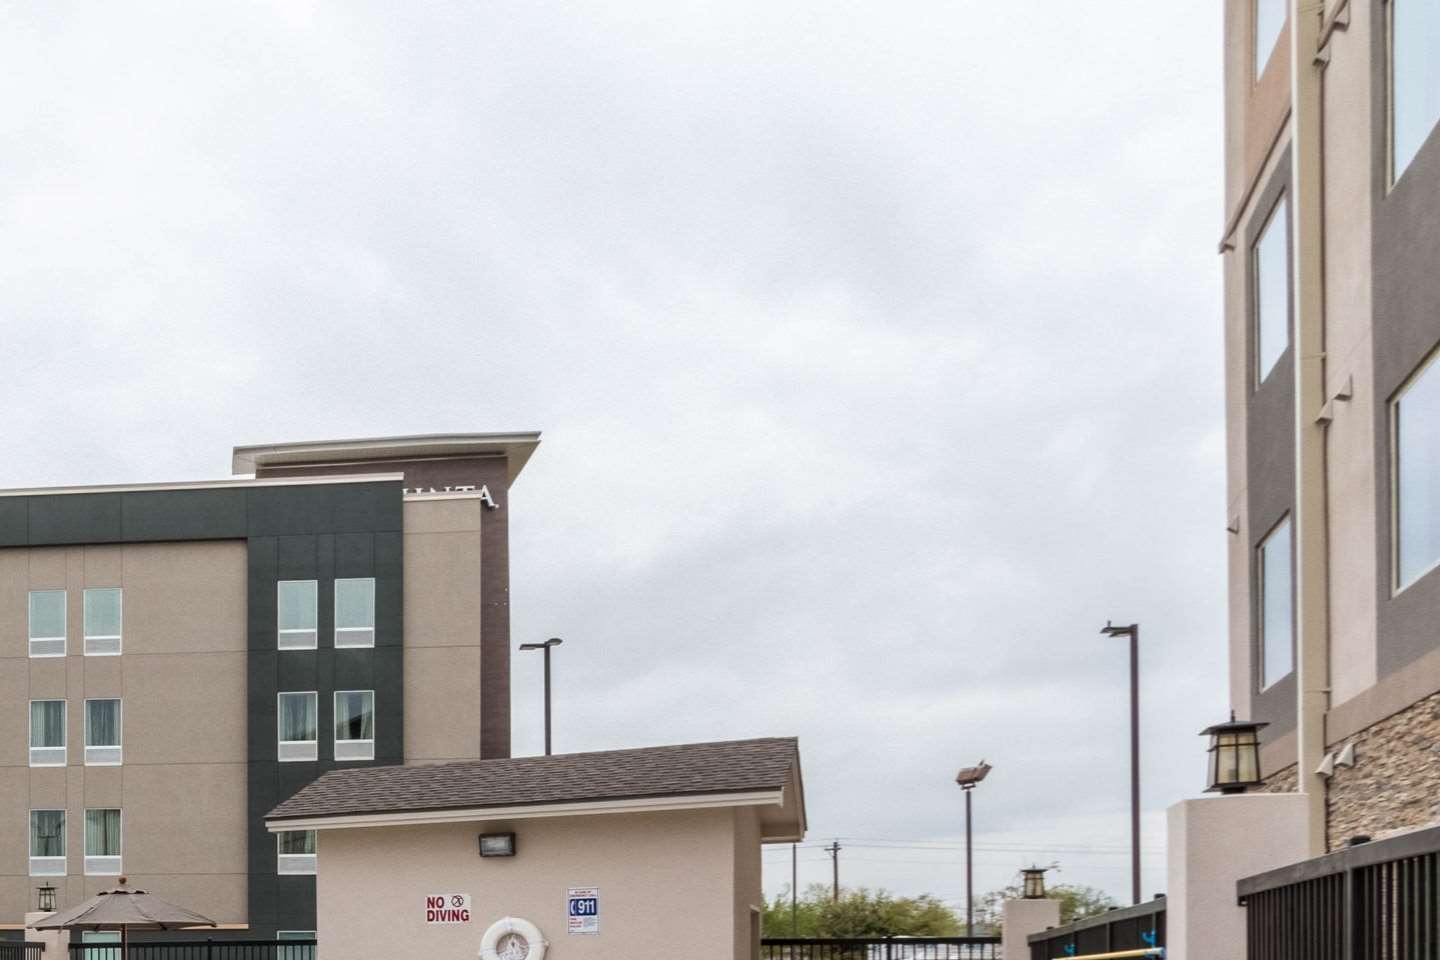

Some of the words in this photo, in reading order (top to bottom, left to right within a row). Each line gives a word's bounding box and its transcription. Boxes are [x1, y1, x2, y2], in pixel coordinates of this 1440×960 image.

[427, 896, 445, 909] NO
[578, 900, 595, 914] 911
[427, 909, 470, 922] DIVING
